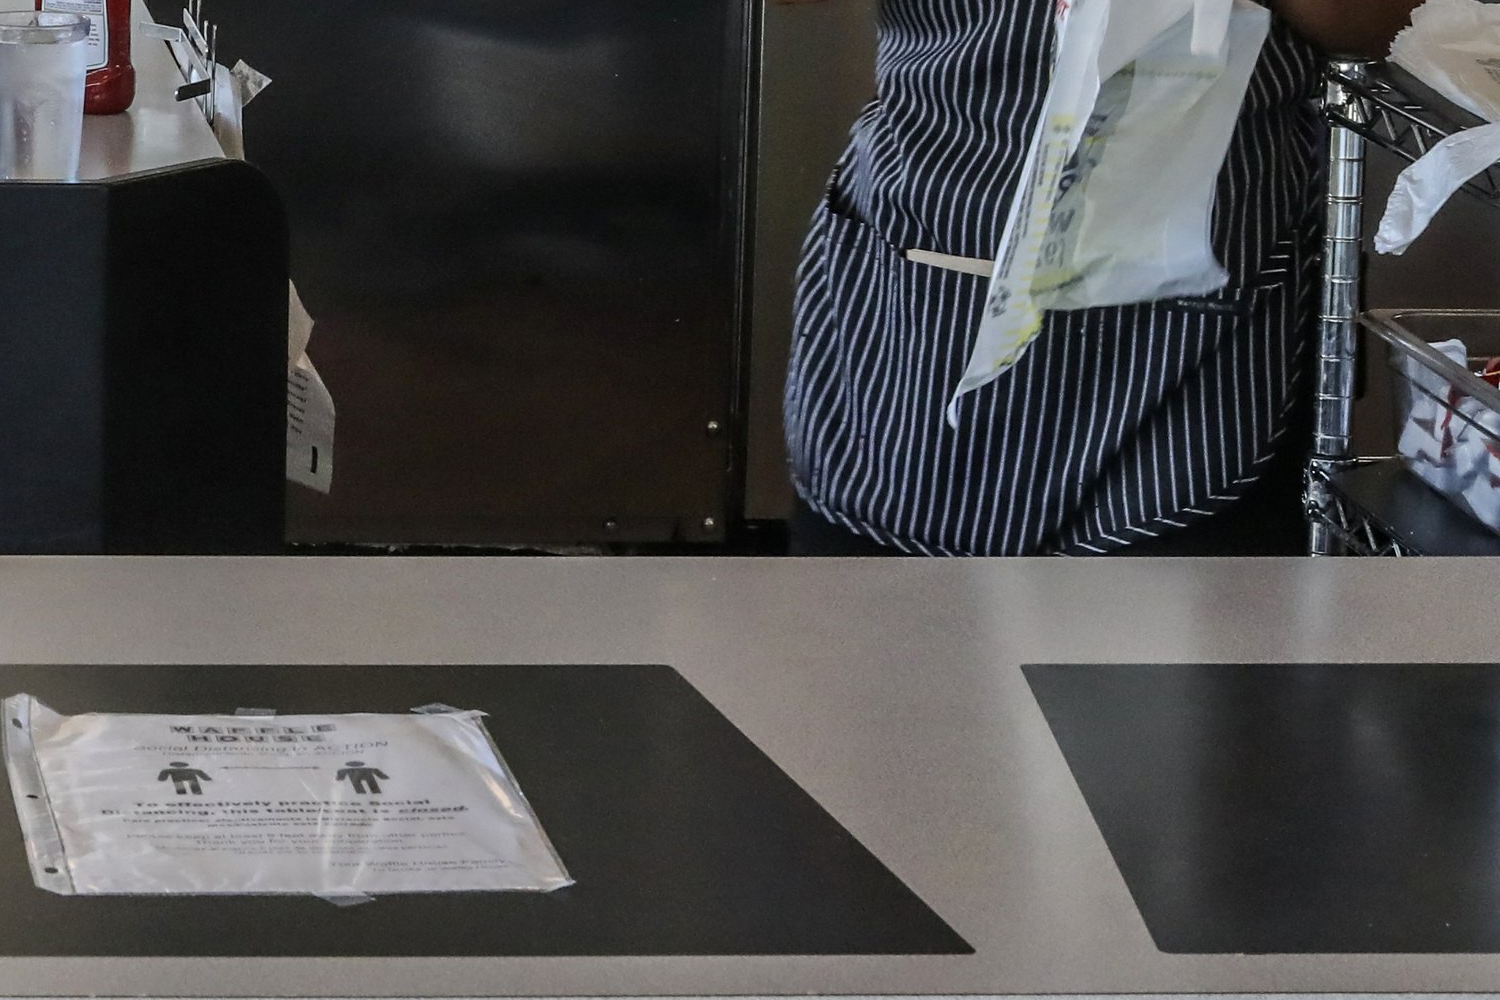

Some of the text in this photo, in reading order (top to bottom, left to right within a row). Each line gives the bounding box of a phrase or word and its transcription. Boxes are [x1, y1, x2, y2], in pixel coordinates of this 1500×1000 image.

[169, 723, 337, 735] WAFFLE
[186, 734, 327, 743] HOUSE
[194, 744, 288, 754] Distancing
[313, 740, 389, 752] ACTION
[165, 800, 271, 808] effectively
[278, 800, 362, 808] practice
[369, 799, 431, 807] Social
[101, 808, 215, 816] Ditancing,
